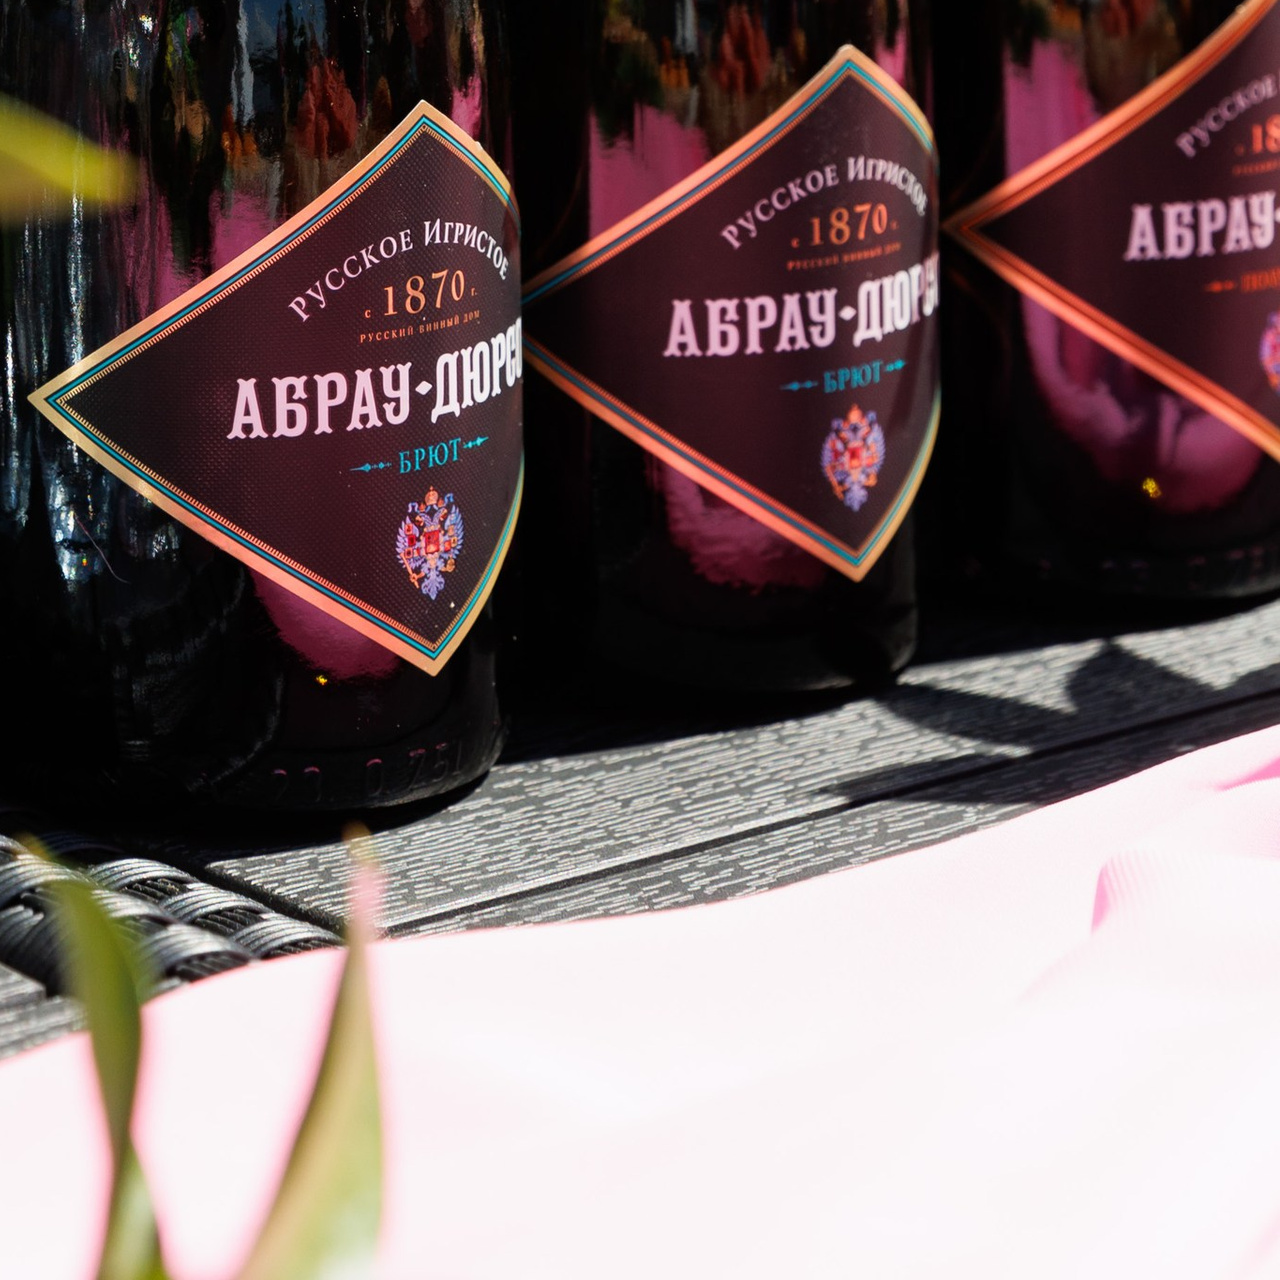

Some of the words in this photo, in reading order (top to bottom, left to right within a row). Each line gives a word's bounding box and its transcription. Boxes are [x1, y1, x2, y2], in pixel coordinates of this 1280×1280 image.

[721, 165, 839, 250] РУССКОЕ
[809, 202, 888, 246] 1870
[288, 229, 414, 322] РУССКОЕ
[424, 218, 509, 281] ИГРИСТОЕ
[383, 268, 465, 316] 1870
[360, 325, 414, 343] РУССКИЙ
[419, 314, 460, 334] ВИННЫЙ
[823, 360, 883, 393] БРЮТ
[399, 437, 461, 474] БРЮТ
